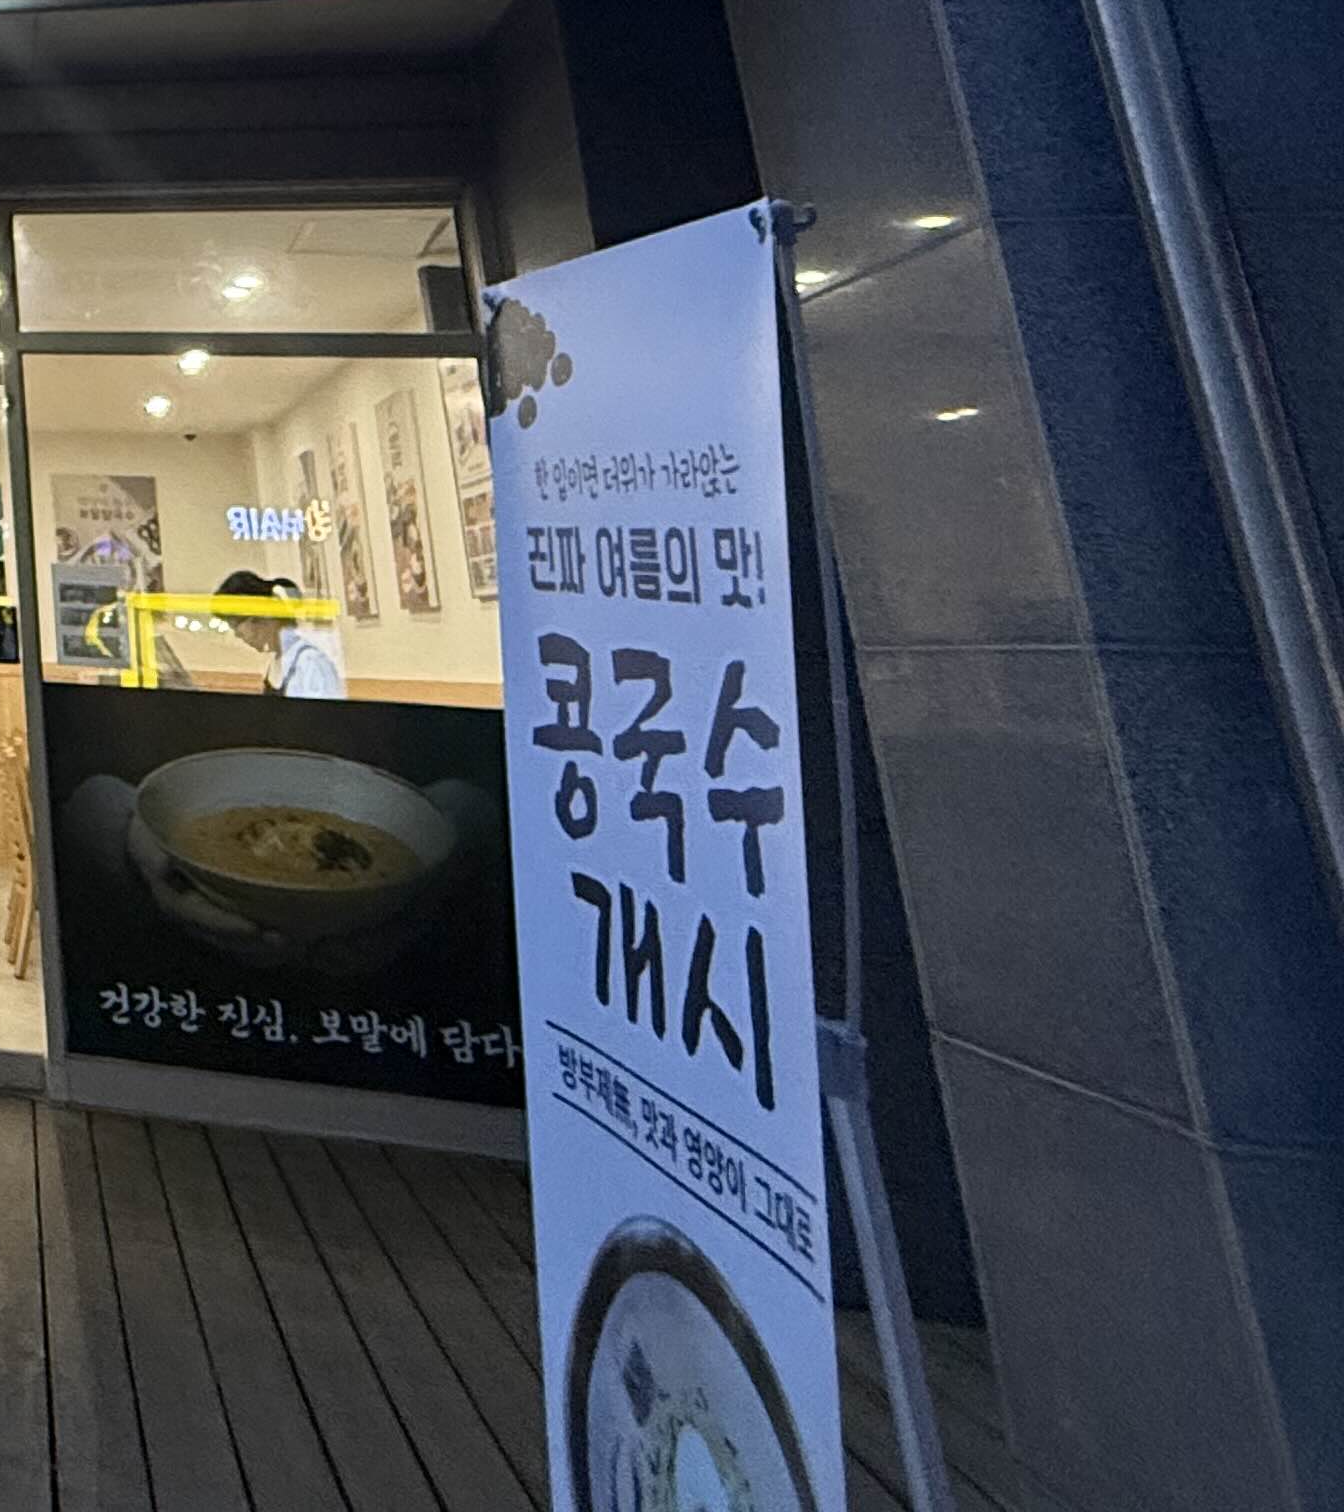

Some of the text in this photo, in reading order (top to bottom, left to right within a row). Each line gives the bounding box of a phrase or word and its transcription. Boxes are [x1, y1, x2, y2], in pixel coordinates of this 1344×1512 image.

[603, 452, 656, 494] 더위가
[661, 443, 741, 498] 가라앉는
[594, 526, 701, 606] 여름의
[532, 632, 784, 898] 콩국수
[99, 981, 205, 1033] 건강한
[218, 995, 299, 1044] 진심.
[312, 1009, 428, 1059] 보말에
[571, 871, 775, 1112] 개시
[640, 1096, 679, 1163] 맛과
[683, 1127, 748, 1213] 영양이
[754, 1176, 816, 1264] 그대로
